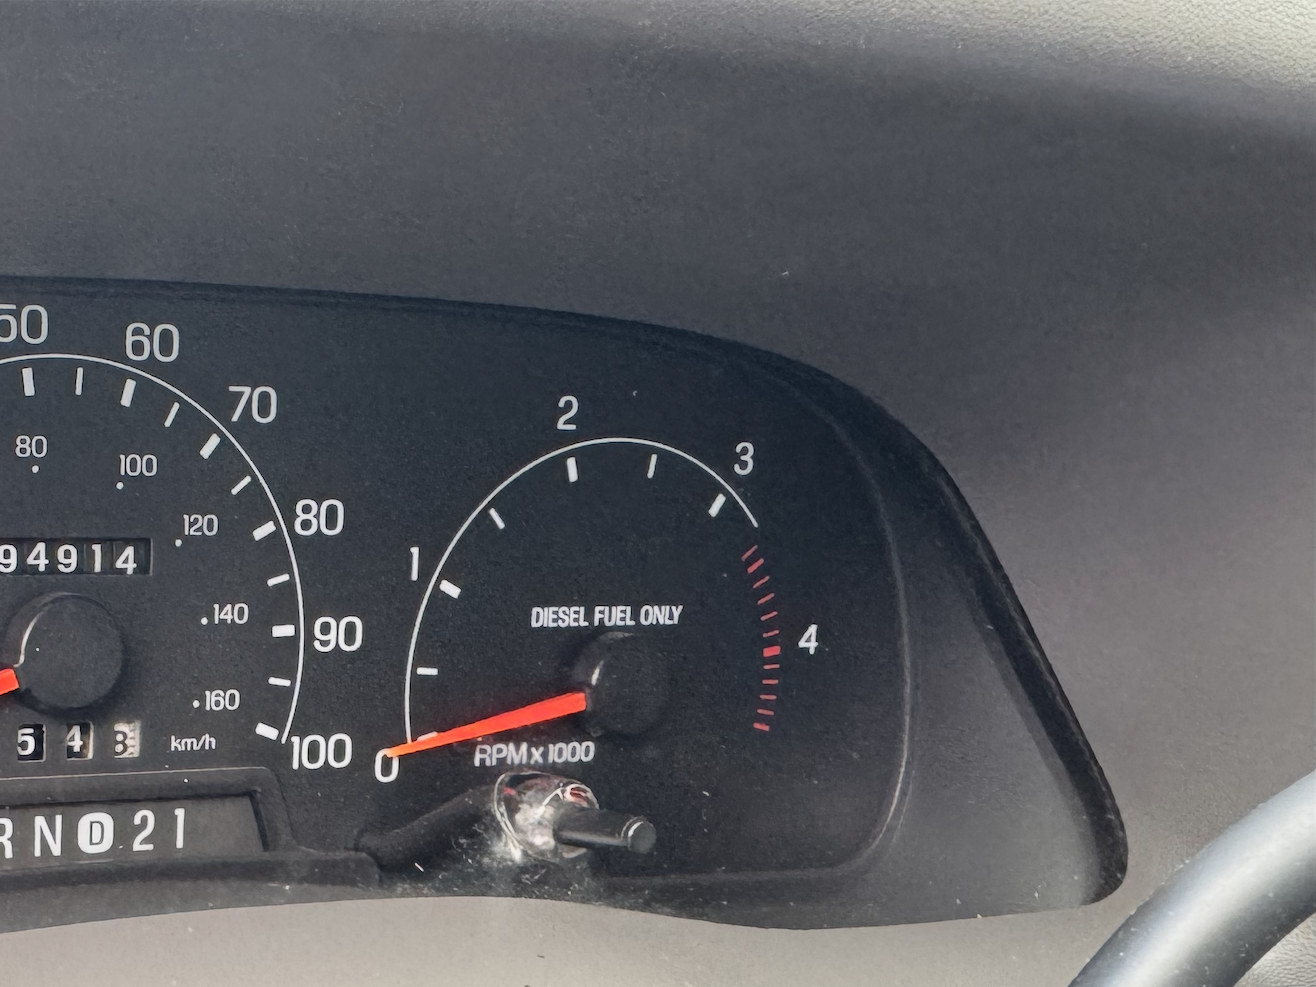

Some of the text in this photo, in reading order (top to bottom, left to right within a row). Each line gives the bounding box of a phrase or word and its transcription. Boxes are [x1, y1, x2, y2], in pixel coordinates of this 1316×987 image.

[125, 322, 180, 363] 60
[228, 385, 278, 424] 70
[556, 395, 579, 431] 2
[15, 435, 48, 458] 80
[733, 441, 755, 476] 3
[119, 453, 158, 477] 100
[185, 514, 219, 536] 120
[294, 498, 345, 536] 80
[409, 546, 420, 582] 1
[213, 602, 249, 625] 140
[530, 604, 684, 628] DIESEL FUEL ONLY
[313, 615, 363, 653] 90
[797, 623, 819, 655] 4
[204, 688, 241, 711] 160
[170, 733, 216, 752] km/h
[291, 733, 353, 770] 100
[473, 741, 528, 767] RPM
[547, 740, 596, 764] 1000
[374, 749, 400, 783] 0
[33, 814, 63, 858] N
[77, 812, 114, 854] D
[132, 809, 155, 852] 2
[174, 807, 185, 849] 1
